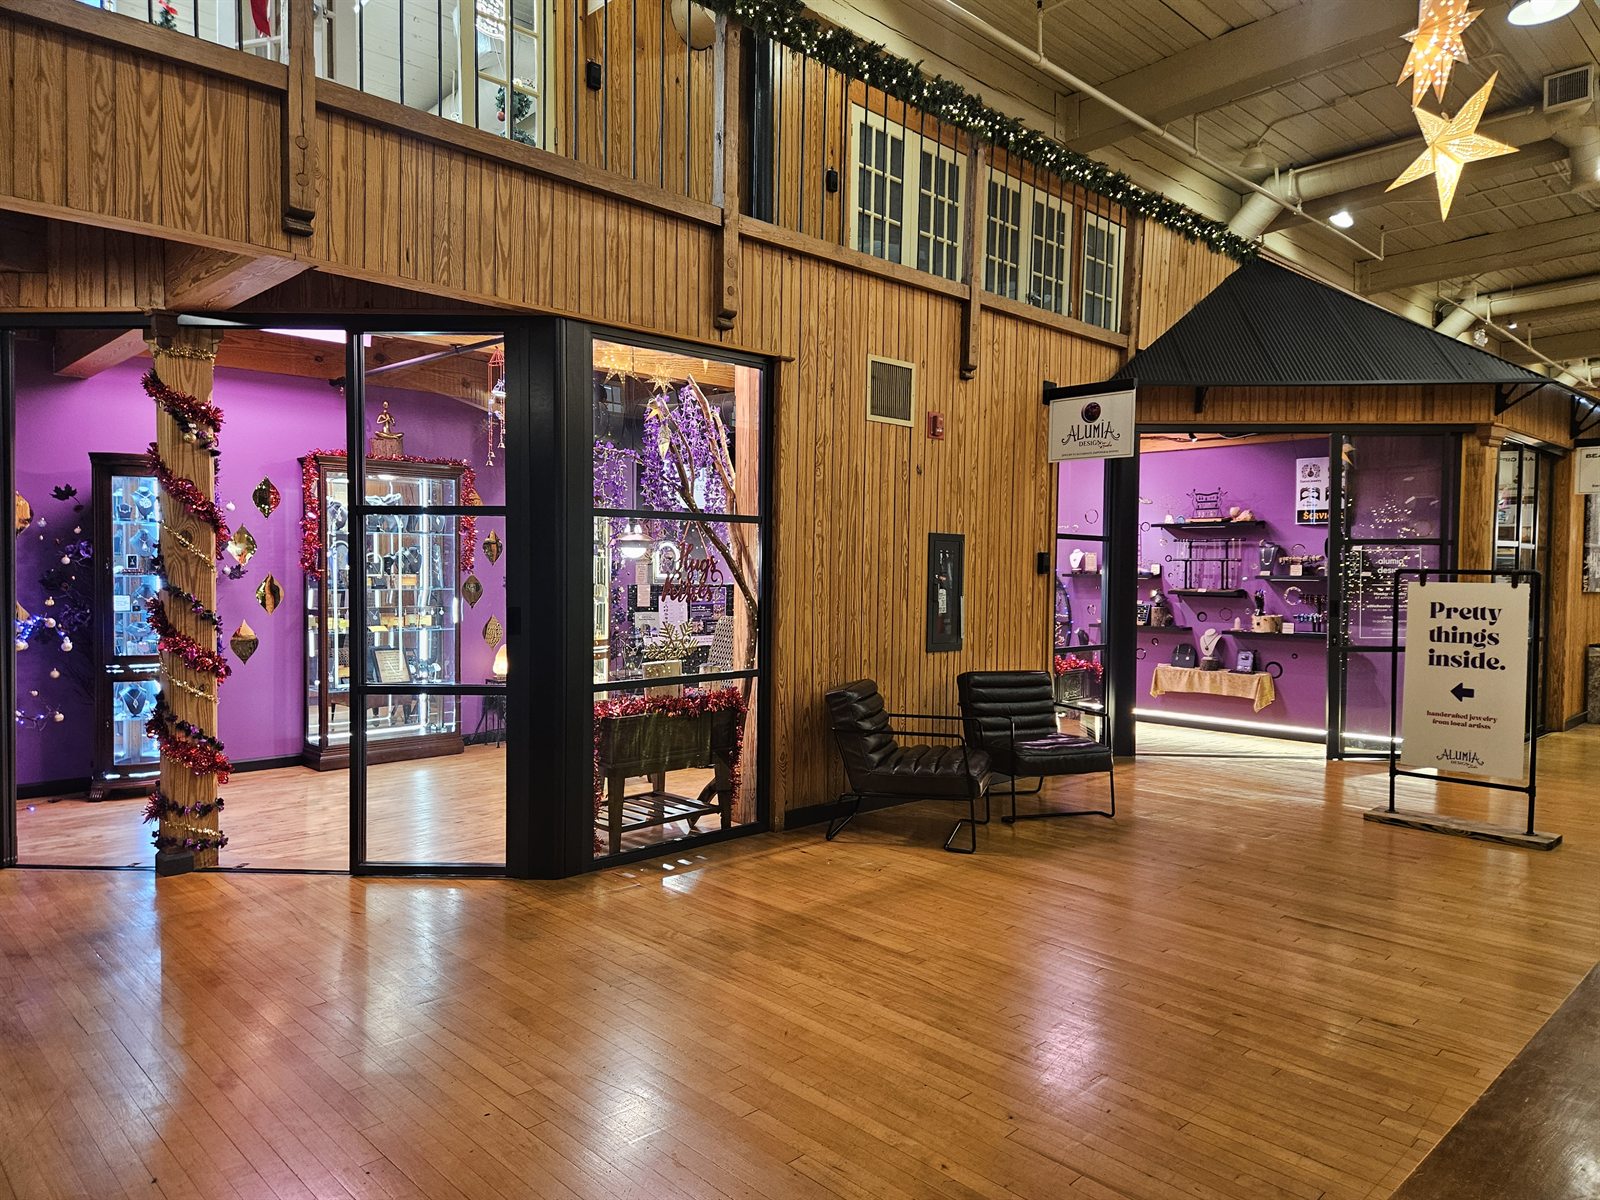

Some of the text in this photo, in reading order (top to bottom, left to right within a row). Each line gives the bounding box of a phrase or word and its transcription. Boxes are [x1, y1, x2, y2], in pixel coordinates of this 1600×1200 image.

[1061, 419, 1121, 445] ALUMIA
[1430, 602, 1502, 626] Pretty
[1429, 626, 1500, 650] things
[1428, 648, 1506, 671] inside.
[1432, 718, 1491, 730] from local artists
[1469, 713, 1497, 724] jewelry
[1436, 748, 1485, 766] ALUMIA
